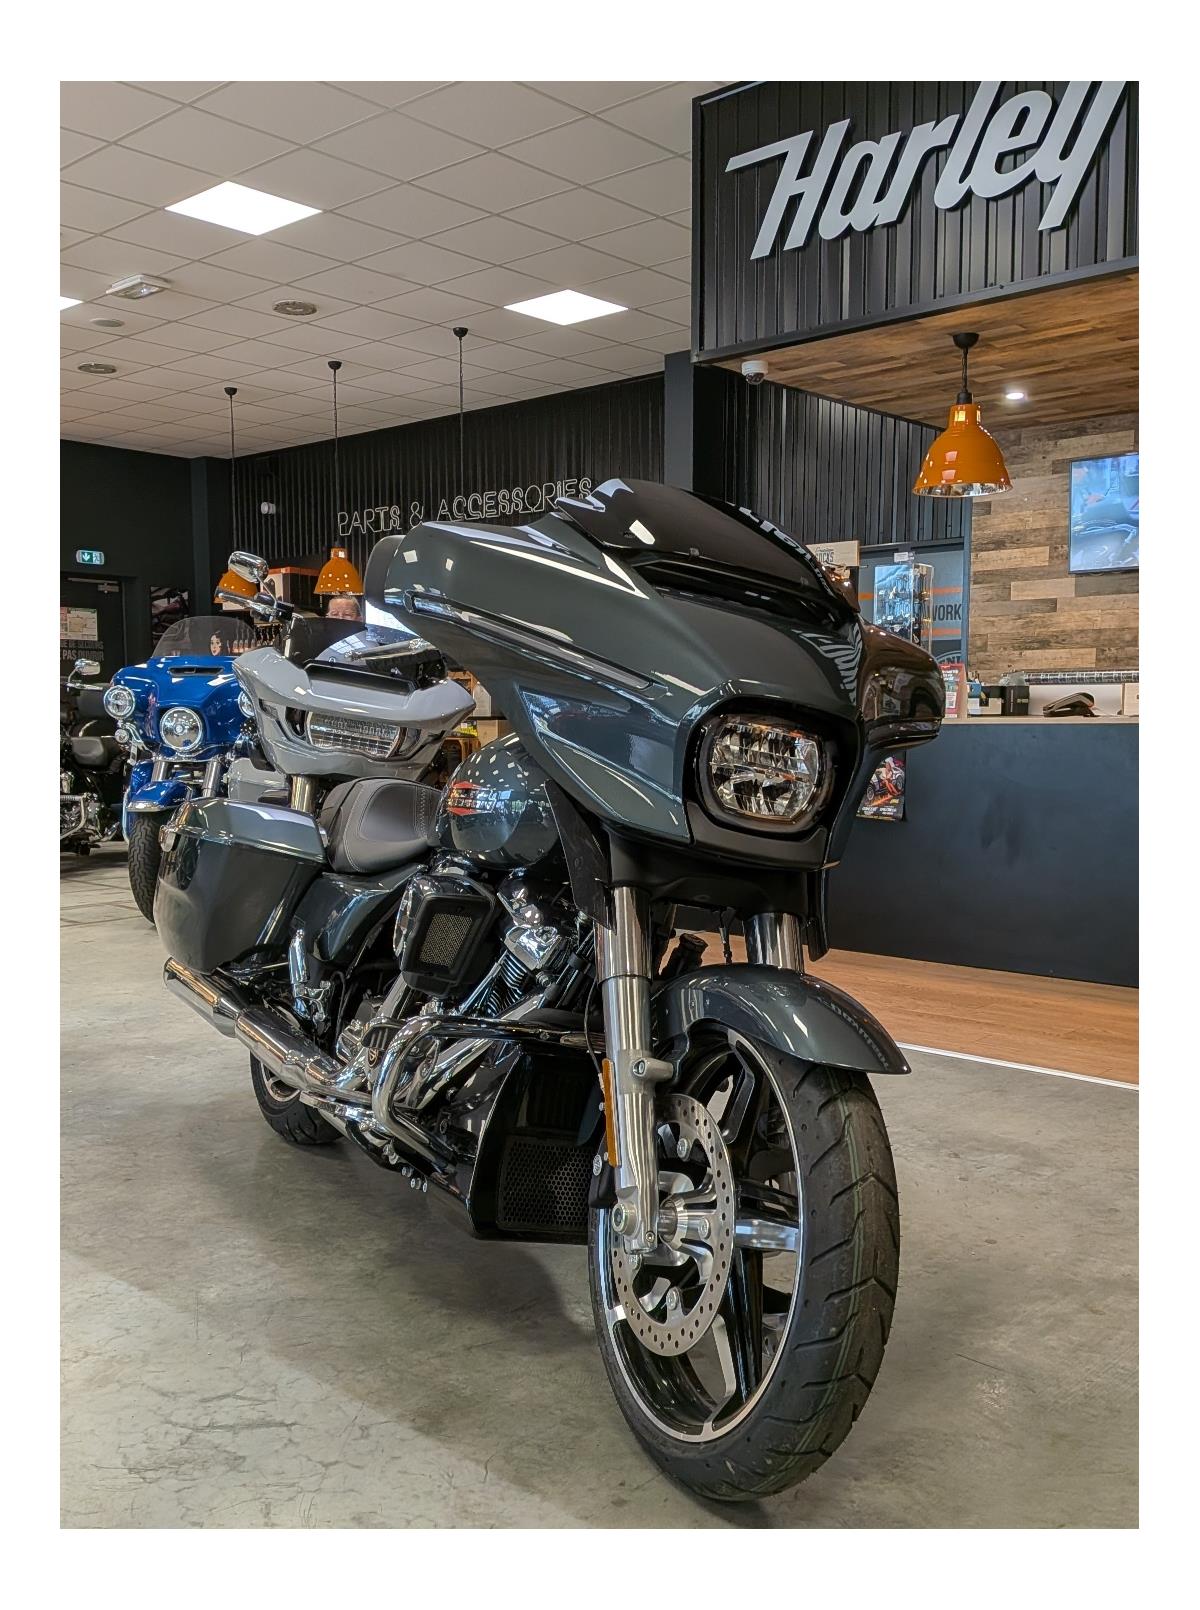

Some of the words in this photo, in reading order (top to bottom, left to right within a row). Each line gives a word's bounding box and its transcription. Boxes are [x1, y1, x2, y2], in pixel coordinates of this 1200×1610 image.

[725, 81, 1127, 260] Harley
[337, 504, 402, 536] PARTS
[409, 501, 424, 528] &
[436, 477, 592, 522] ACCESSORIES
[62, 649, 77, 660] PAS
